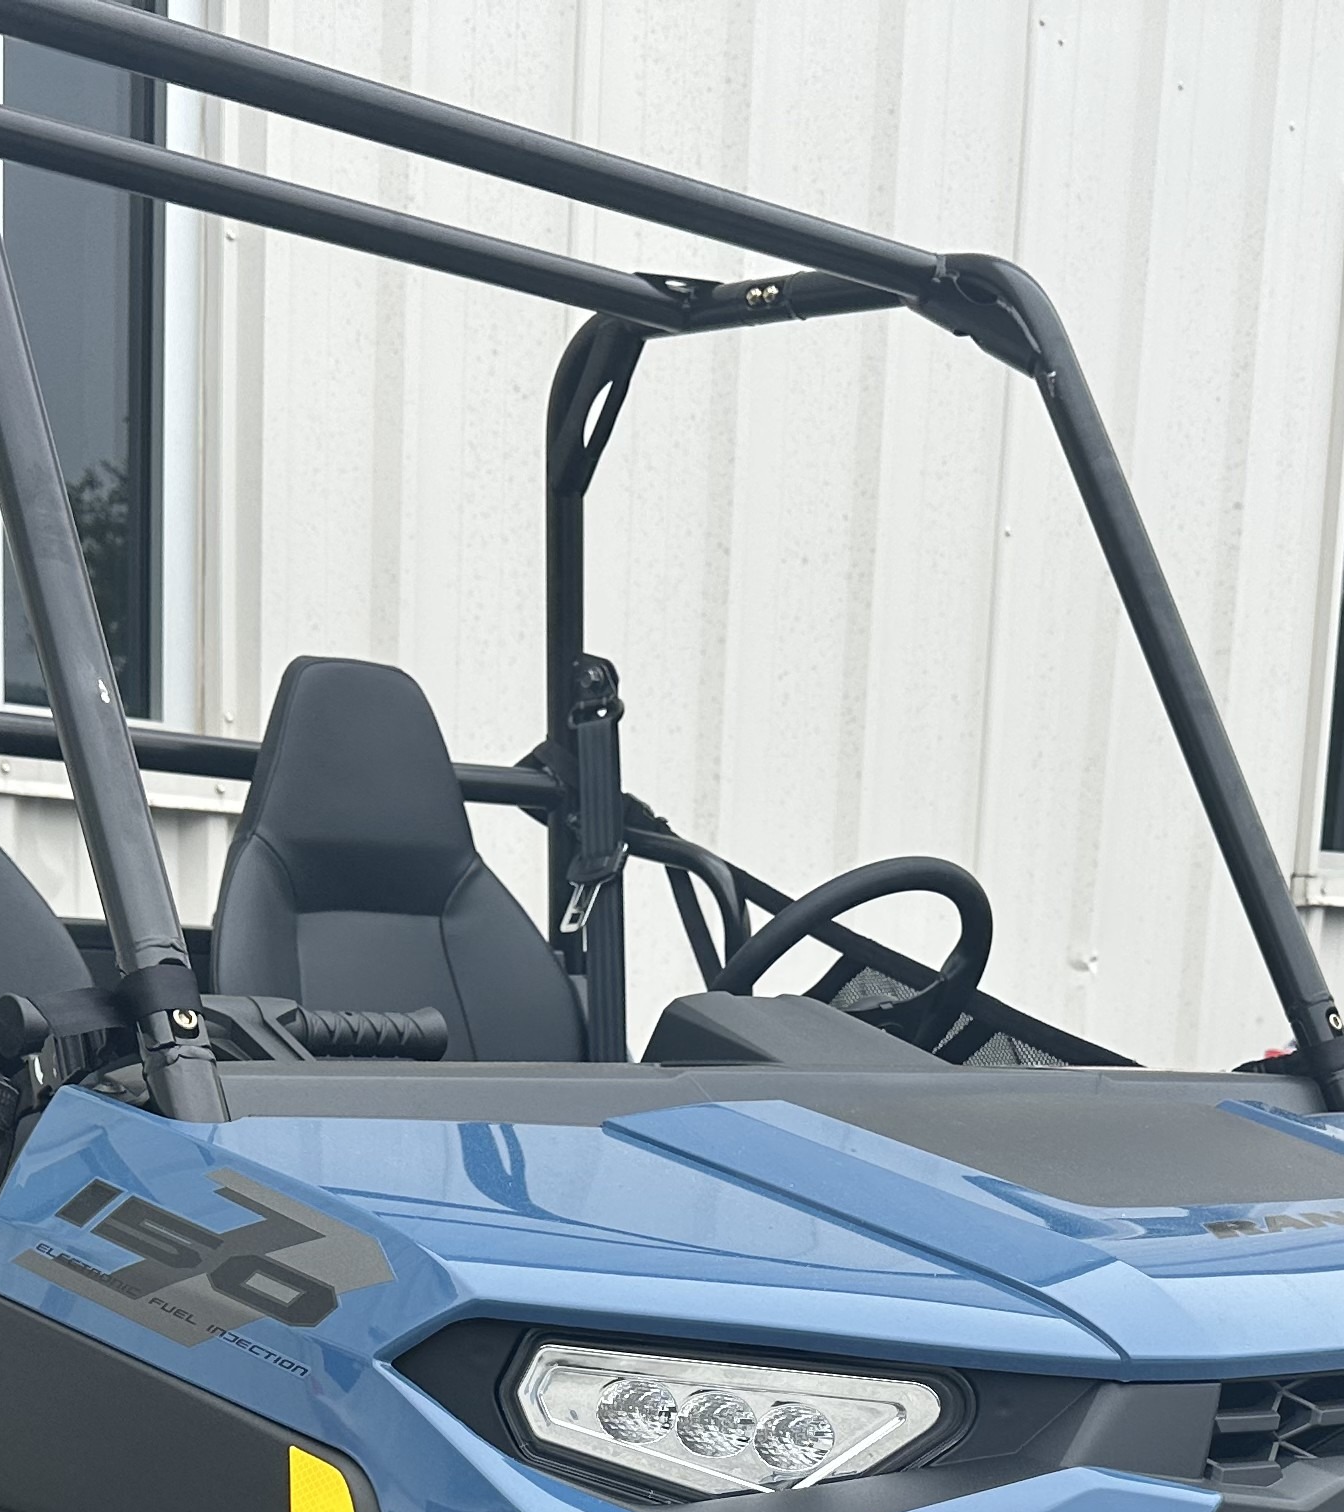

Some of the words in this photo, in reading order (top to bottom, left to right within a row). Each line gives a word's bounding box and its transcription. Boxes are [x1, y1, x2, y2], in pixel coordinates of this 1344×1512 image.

[36, 1242, 143, 1297] ELECTRONIC
[148, 1298, 197, 1325] FUEL
[206, 1324, 309, 1377] INJECTION
[55, 1178, 339, 1328] 150
